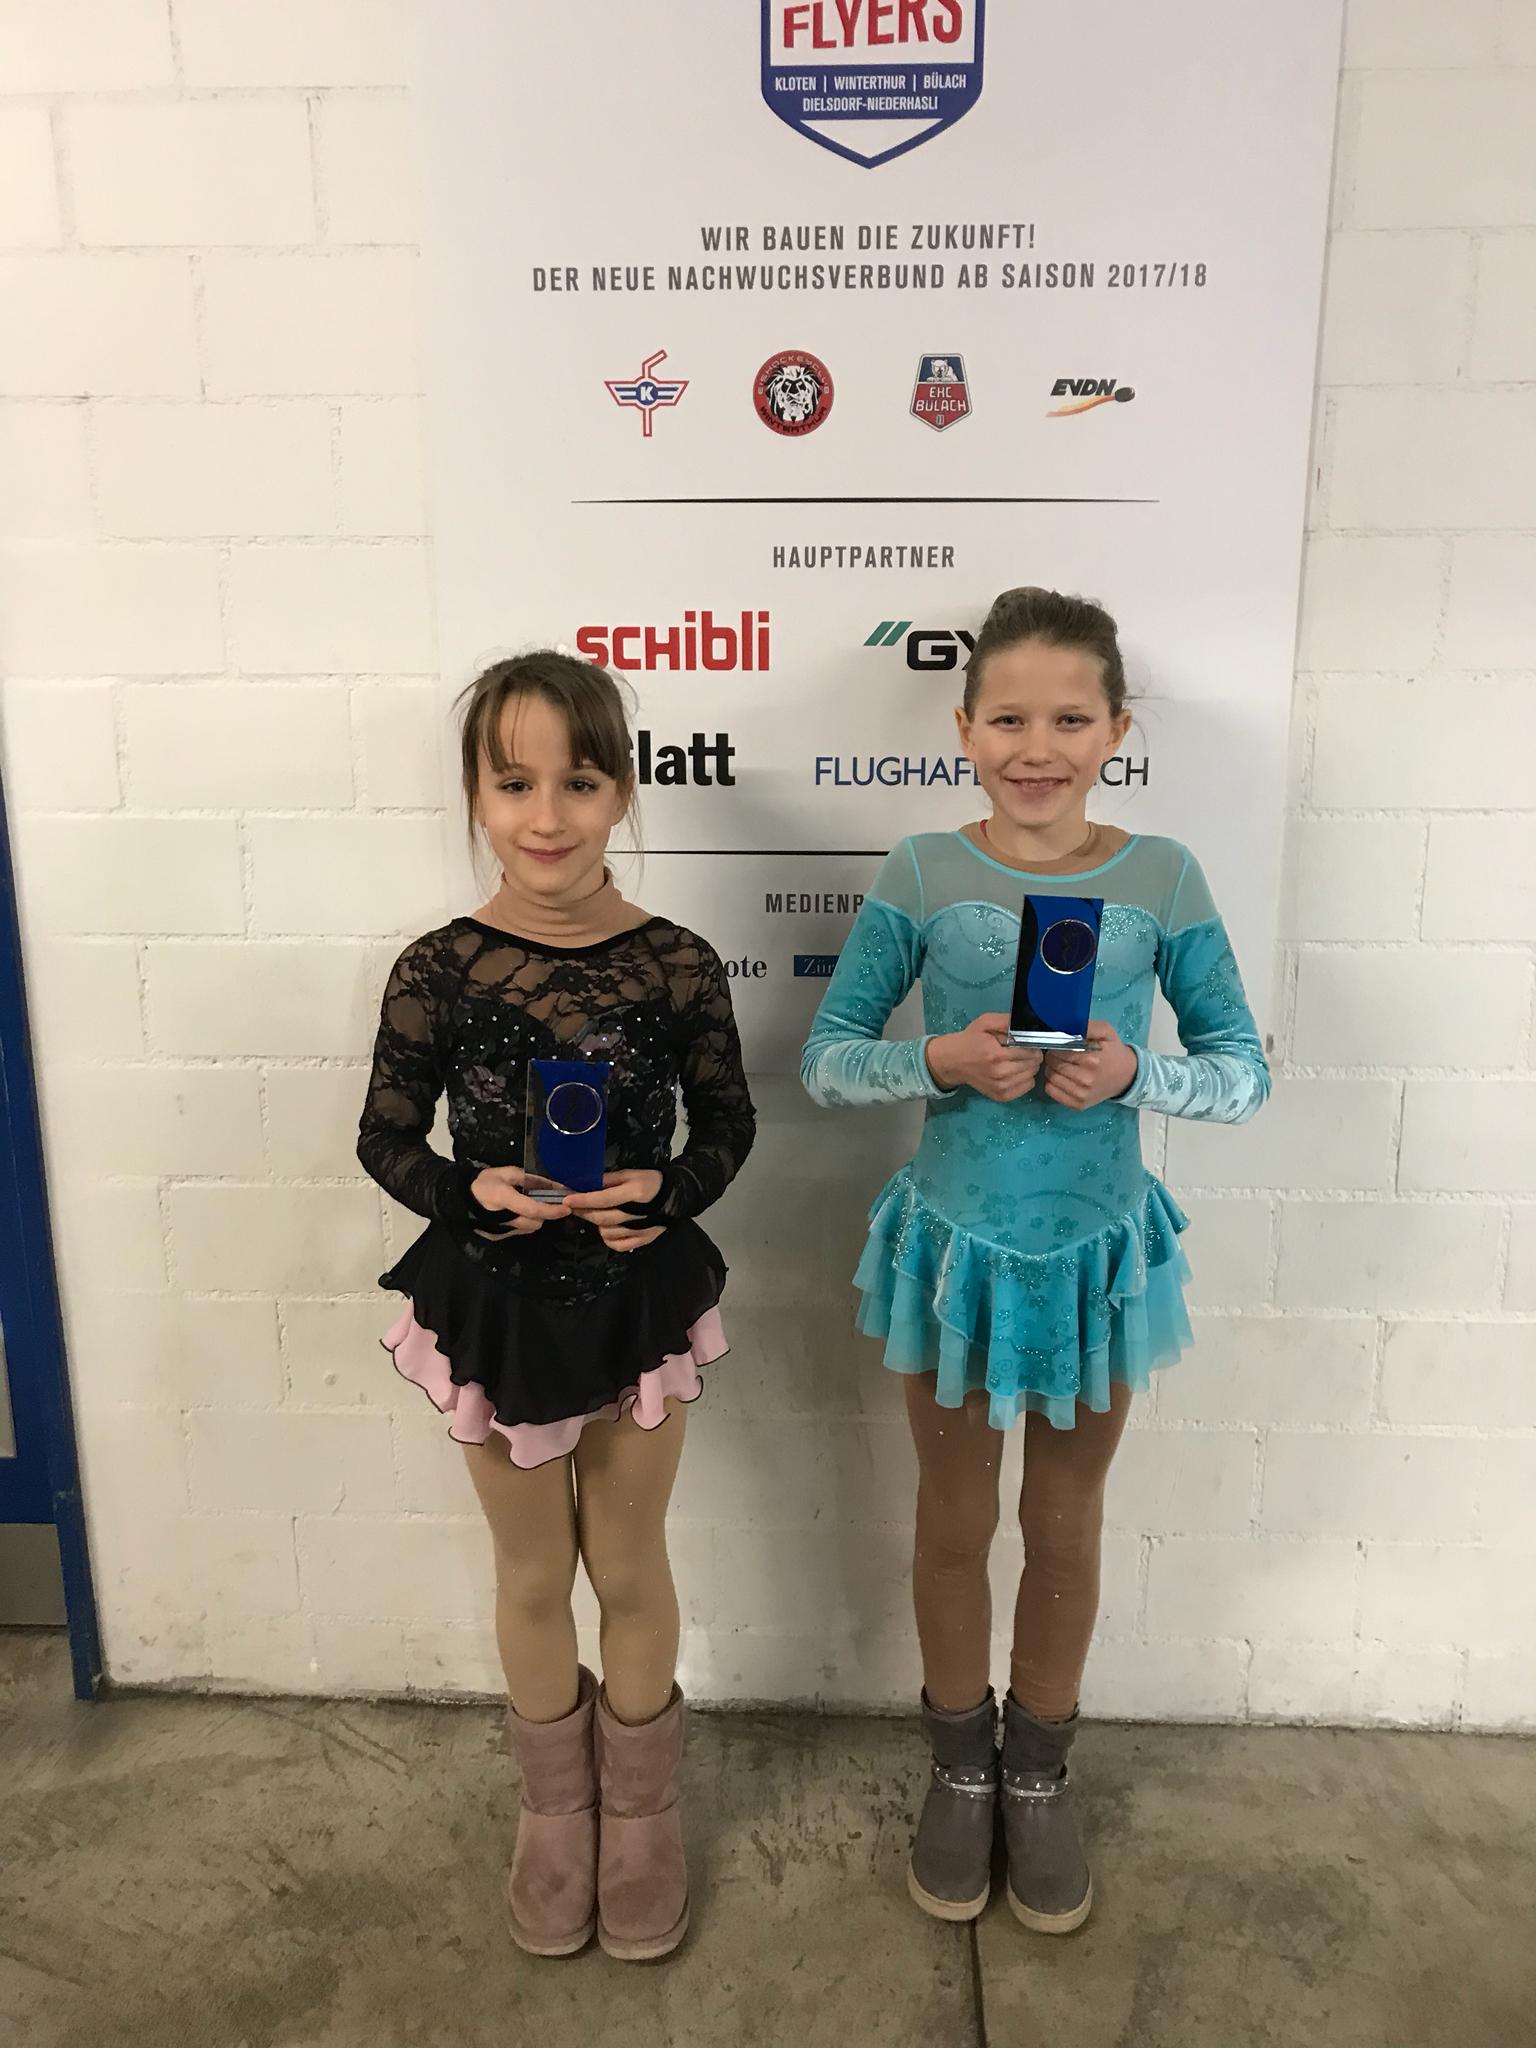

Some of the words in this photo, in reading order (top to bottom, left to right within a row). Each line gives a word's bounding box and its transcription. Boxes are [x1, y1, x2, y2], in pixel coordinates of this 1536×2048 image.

[783, 0, 963, 49] FLYERS
[775, 76, 817, 91] KLOTEN
[834, 74, 906, 91] WINTERTHUR
[923, 72, 967, 89] BÜLACH
[802, 95, 938, 112] DIELSDORF-NIEDERHASLI
[701, 226, 750, 251] WIR
[762, 225, 844, 251] BAUEN
[858, 225, 898, 250] DIE
[911, 223, 1036, 250] ZUKUNFT!
[532, 266, 580, 292] DER
[592, 265, 656, 292] NEUE
[667, 264, 945, 291] NACHWUCHSVERBUND
[957, 264, 989, 289] AB
[1001, 262, 1095, 289] SAISON
[1107, 262, 1208, 288] 2017/18
[640, 386, 655, 401] K
[929, 386, 953, 398] EHC
[1050, 378, 1117, 397] EVDN
[773, 545, 955, 569] HAUPTPARTNER
[630, 730, 736, 786] latt
